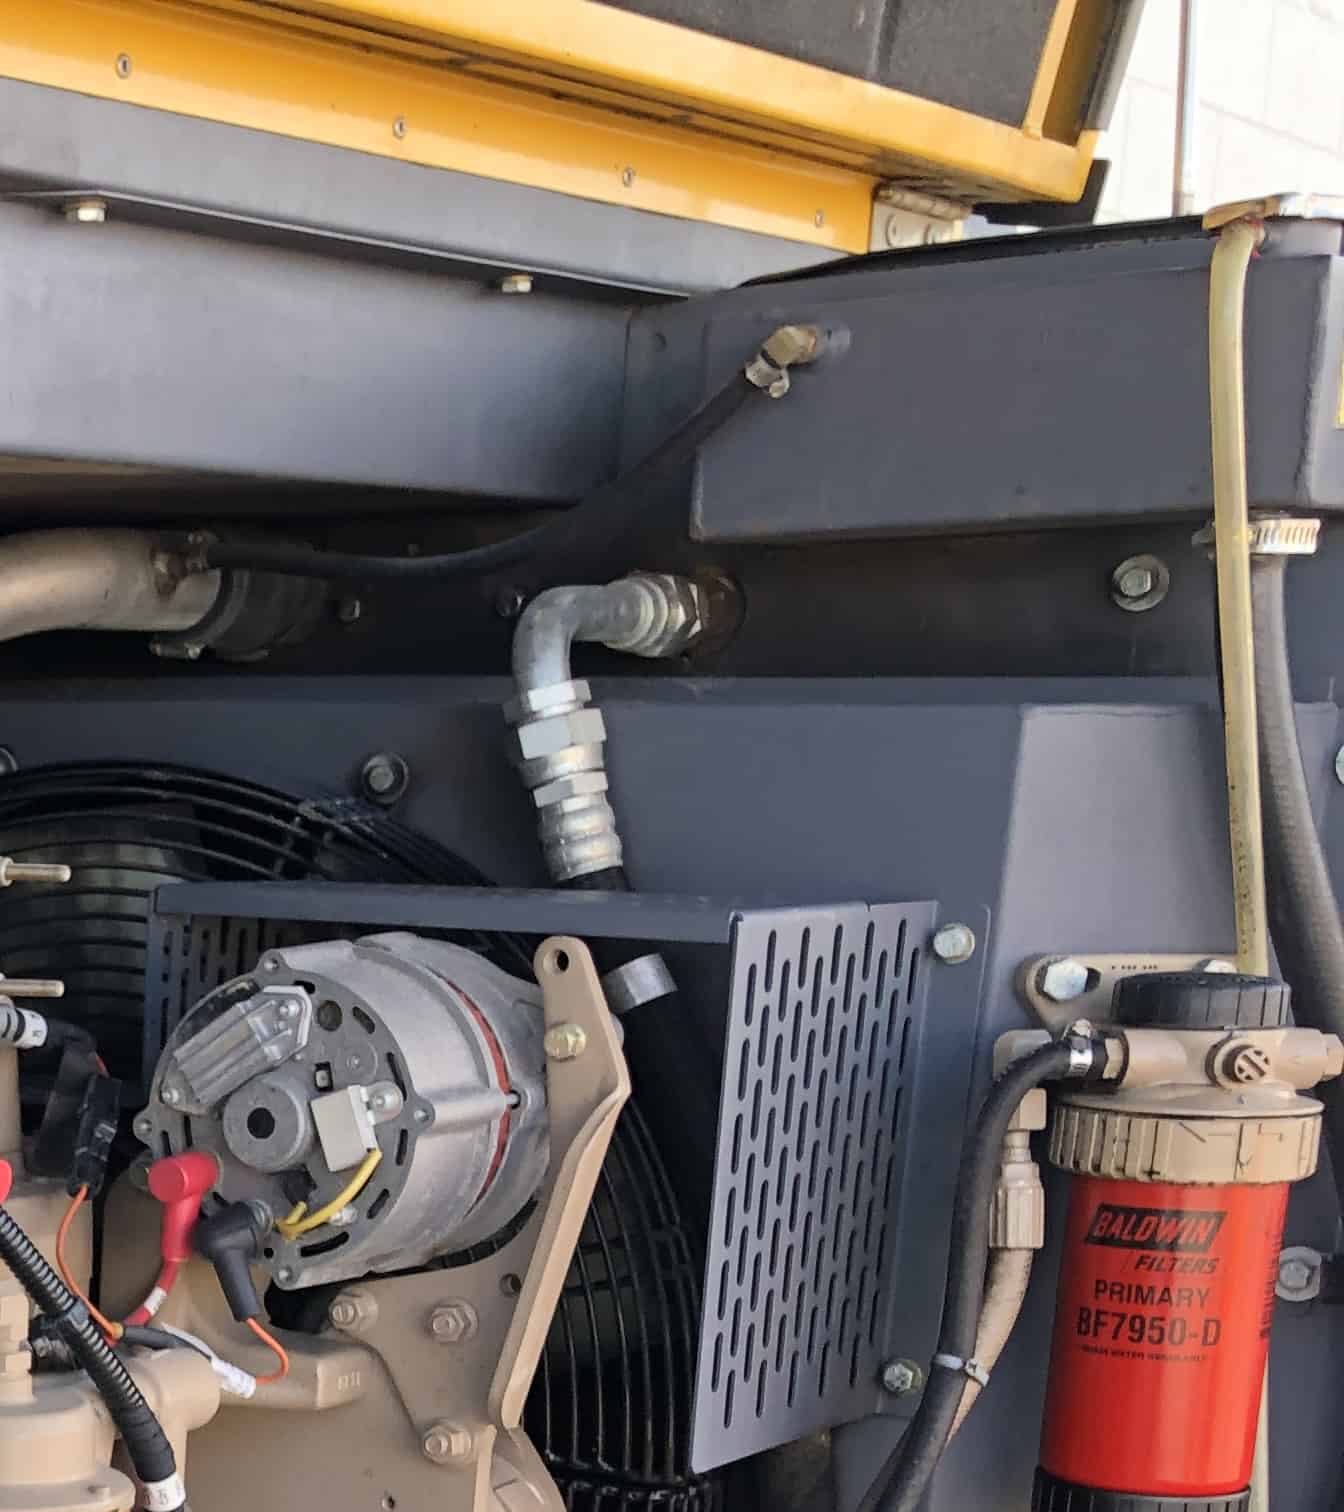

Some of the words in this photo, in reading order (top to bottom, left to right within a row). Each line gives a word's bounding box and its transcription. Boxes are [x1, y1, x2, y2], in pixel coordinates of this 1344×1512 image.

[1091, 1207, 1219, 1247] BALDWIN
[1134, 1254, 1220, 1274] FILTERS
[1094, 1279, 1211, 1308] PRIMARY
[1076, 1307, 1222, 1347] BF7950-D
